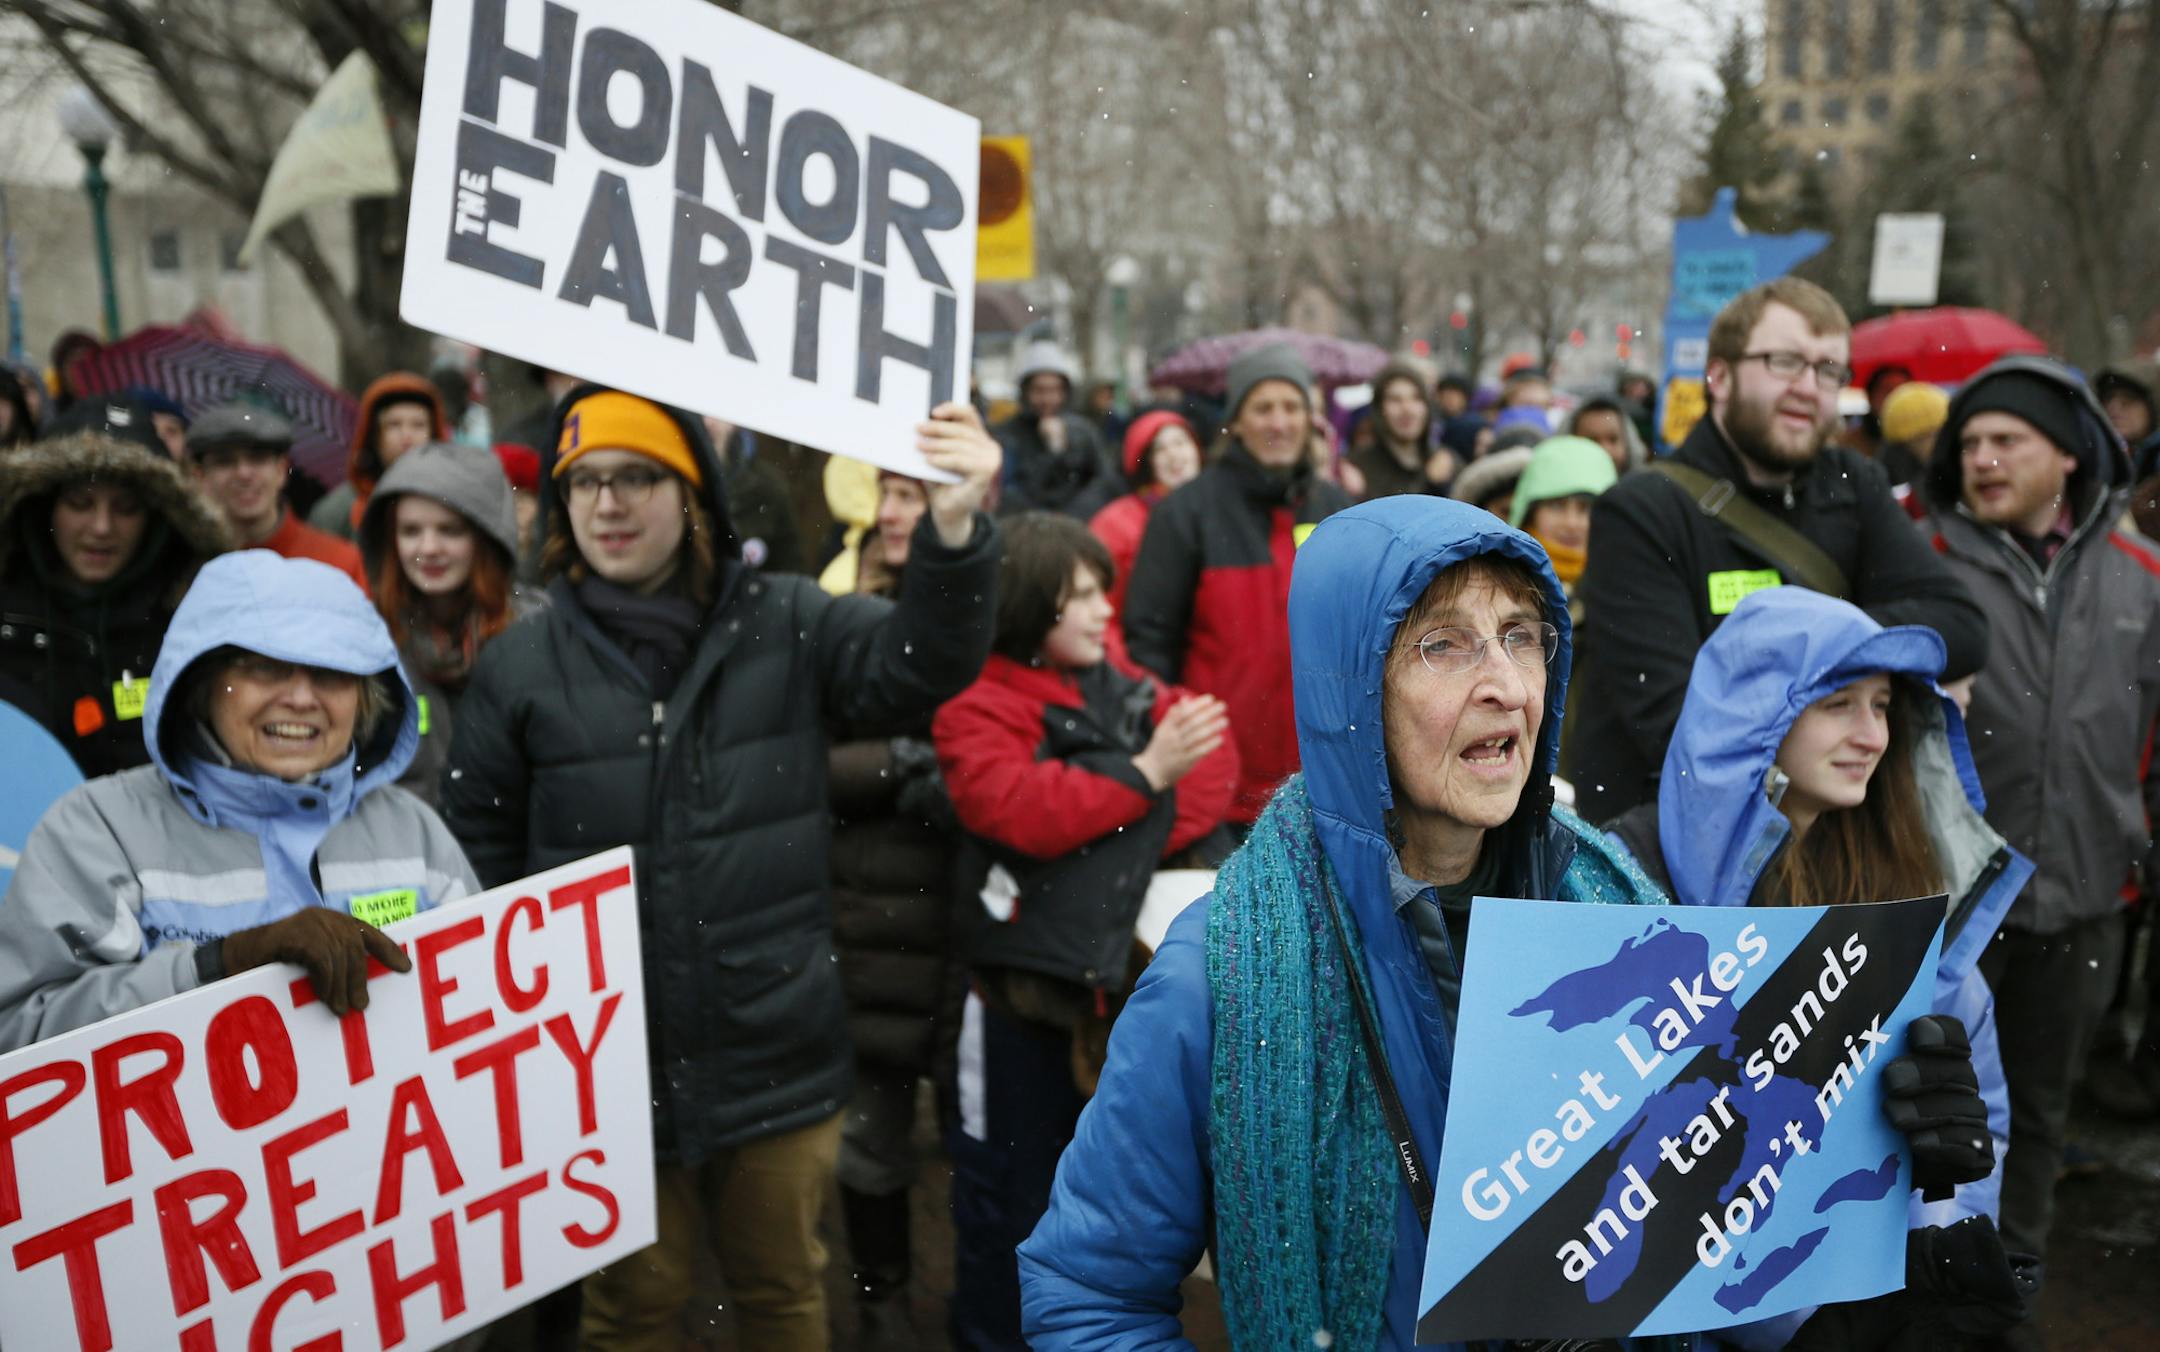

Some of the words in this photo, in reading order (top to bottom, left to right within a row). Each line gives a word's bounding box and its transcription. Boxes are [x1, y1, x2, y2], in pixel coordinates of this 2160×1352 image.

[446, 119, 958, 420] EARTH
[455, 168, 488, 235] THE
[462, 0, 964, 291] HONOR
[0, 866, 632, 1229] PROTECT
[12, 991, 624, 1352] TREATY
[1399, 1141, 1420, 1183] LUMIX
[1461, 1067, 1621, 1221] Great
[1615, 922, 1768, 1080] Lakes
[1555, 1165, 1660, 1282] and
[1658, 1086, 1737, 1175] tar
[1744, 932, 1868, 1092] sands
[1694, 1120, 1813, 1269] don't
[1814, 1013, 1892, 1124] mix
